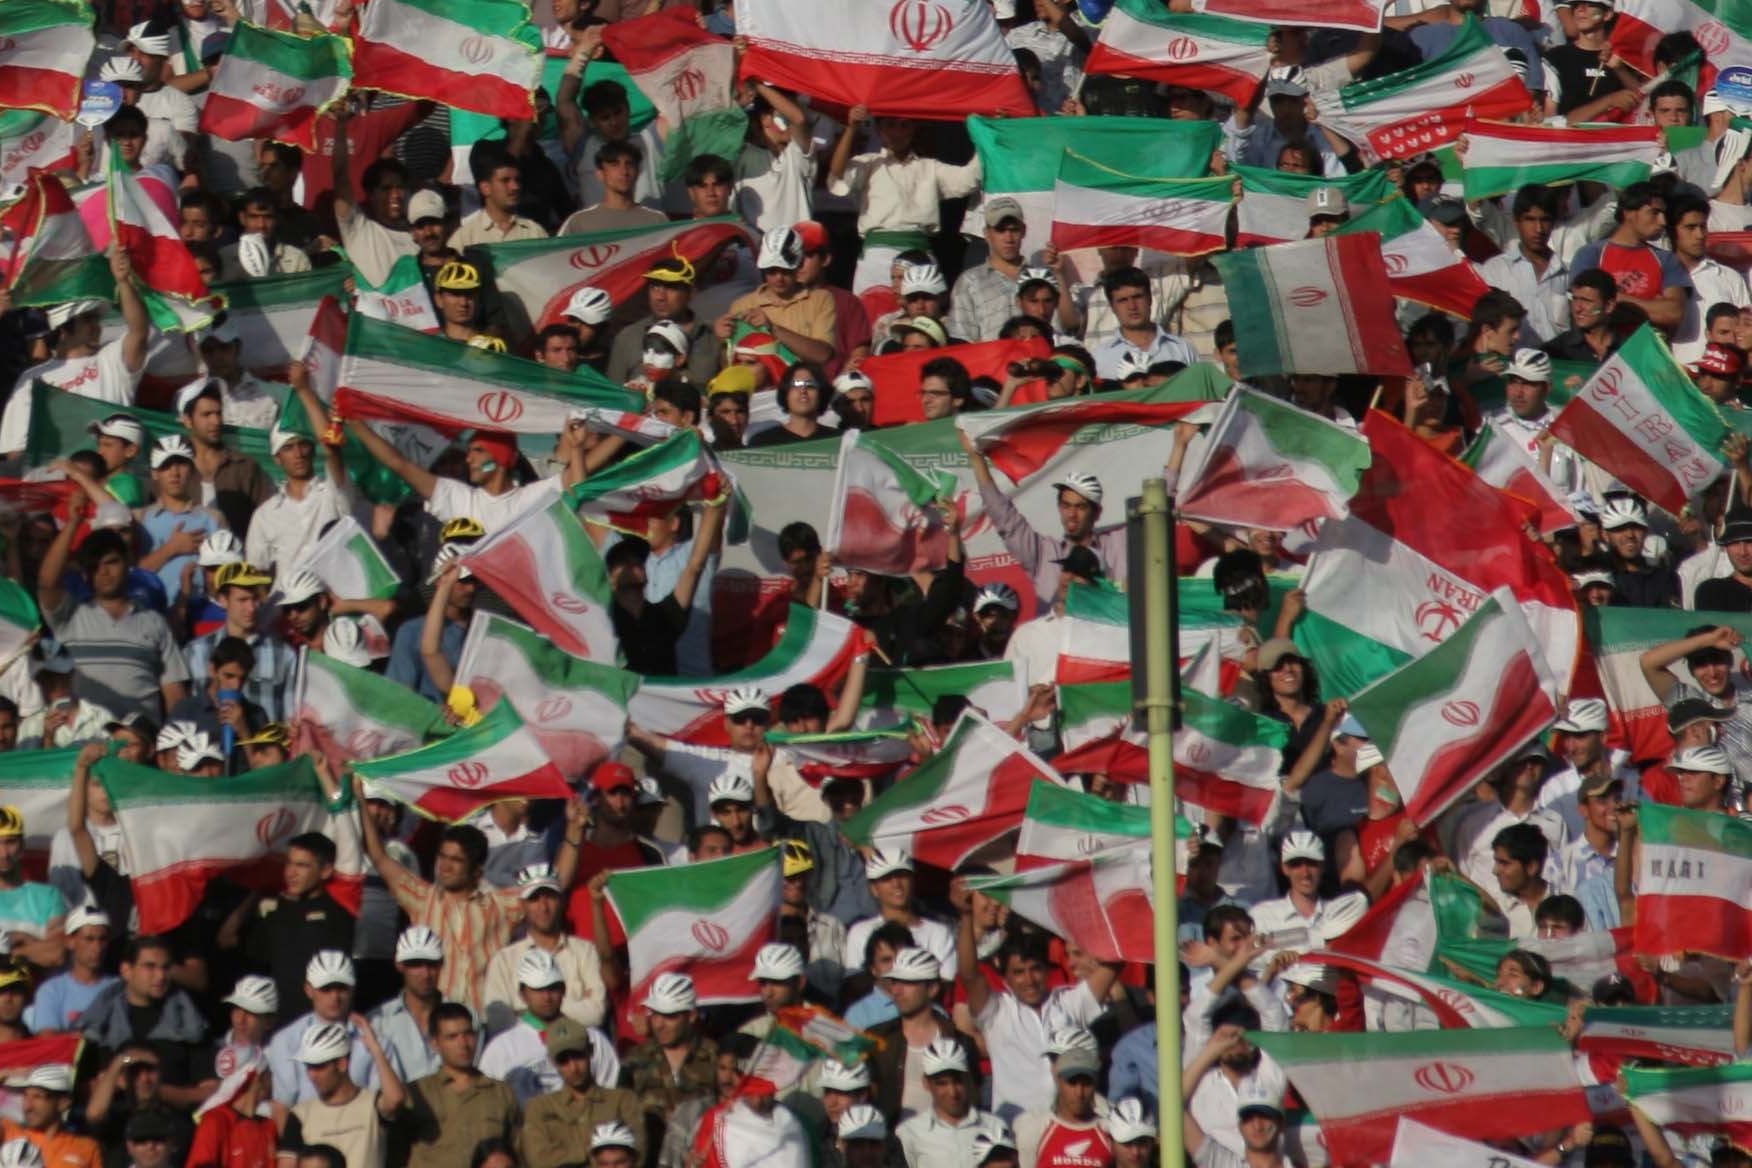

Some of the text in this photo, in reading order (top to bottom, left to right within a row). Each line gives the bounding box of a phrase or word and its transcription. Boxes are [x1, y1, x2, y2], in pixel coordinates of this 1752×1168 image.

[1613, 394, 1710, 489] IRAN
[1426, 572, 1482, 612] IRAN
[1053, 1156, 1102, 1167] HONDA
